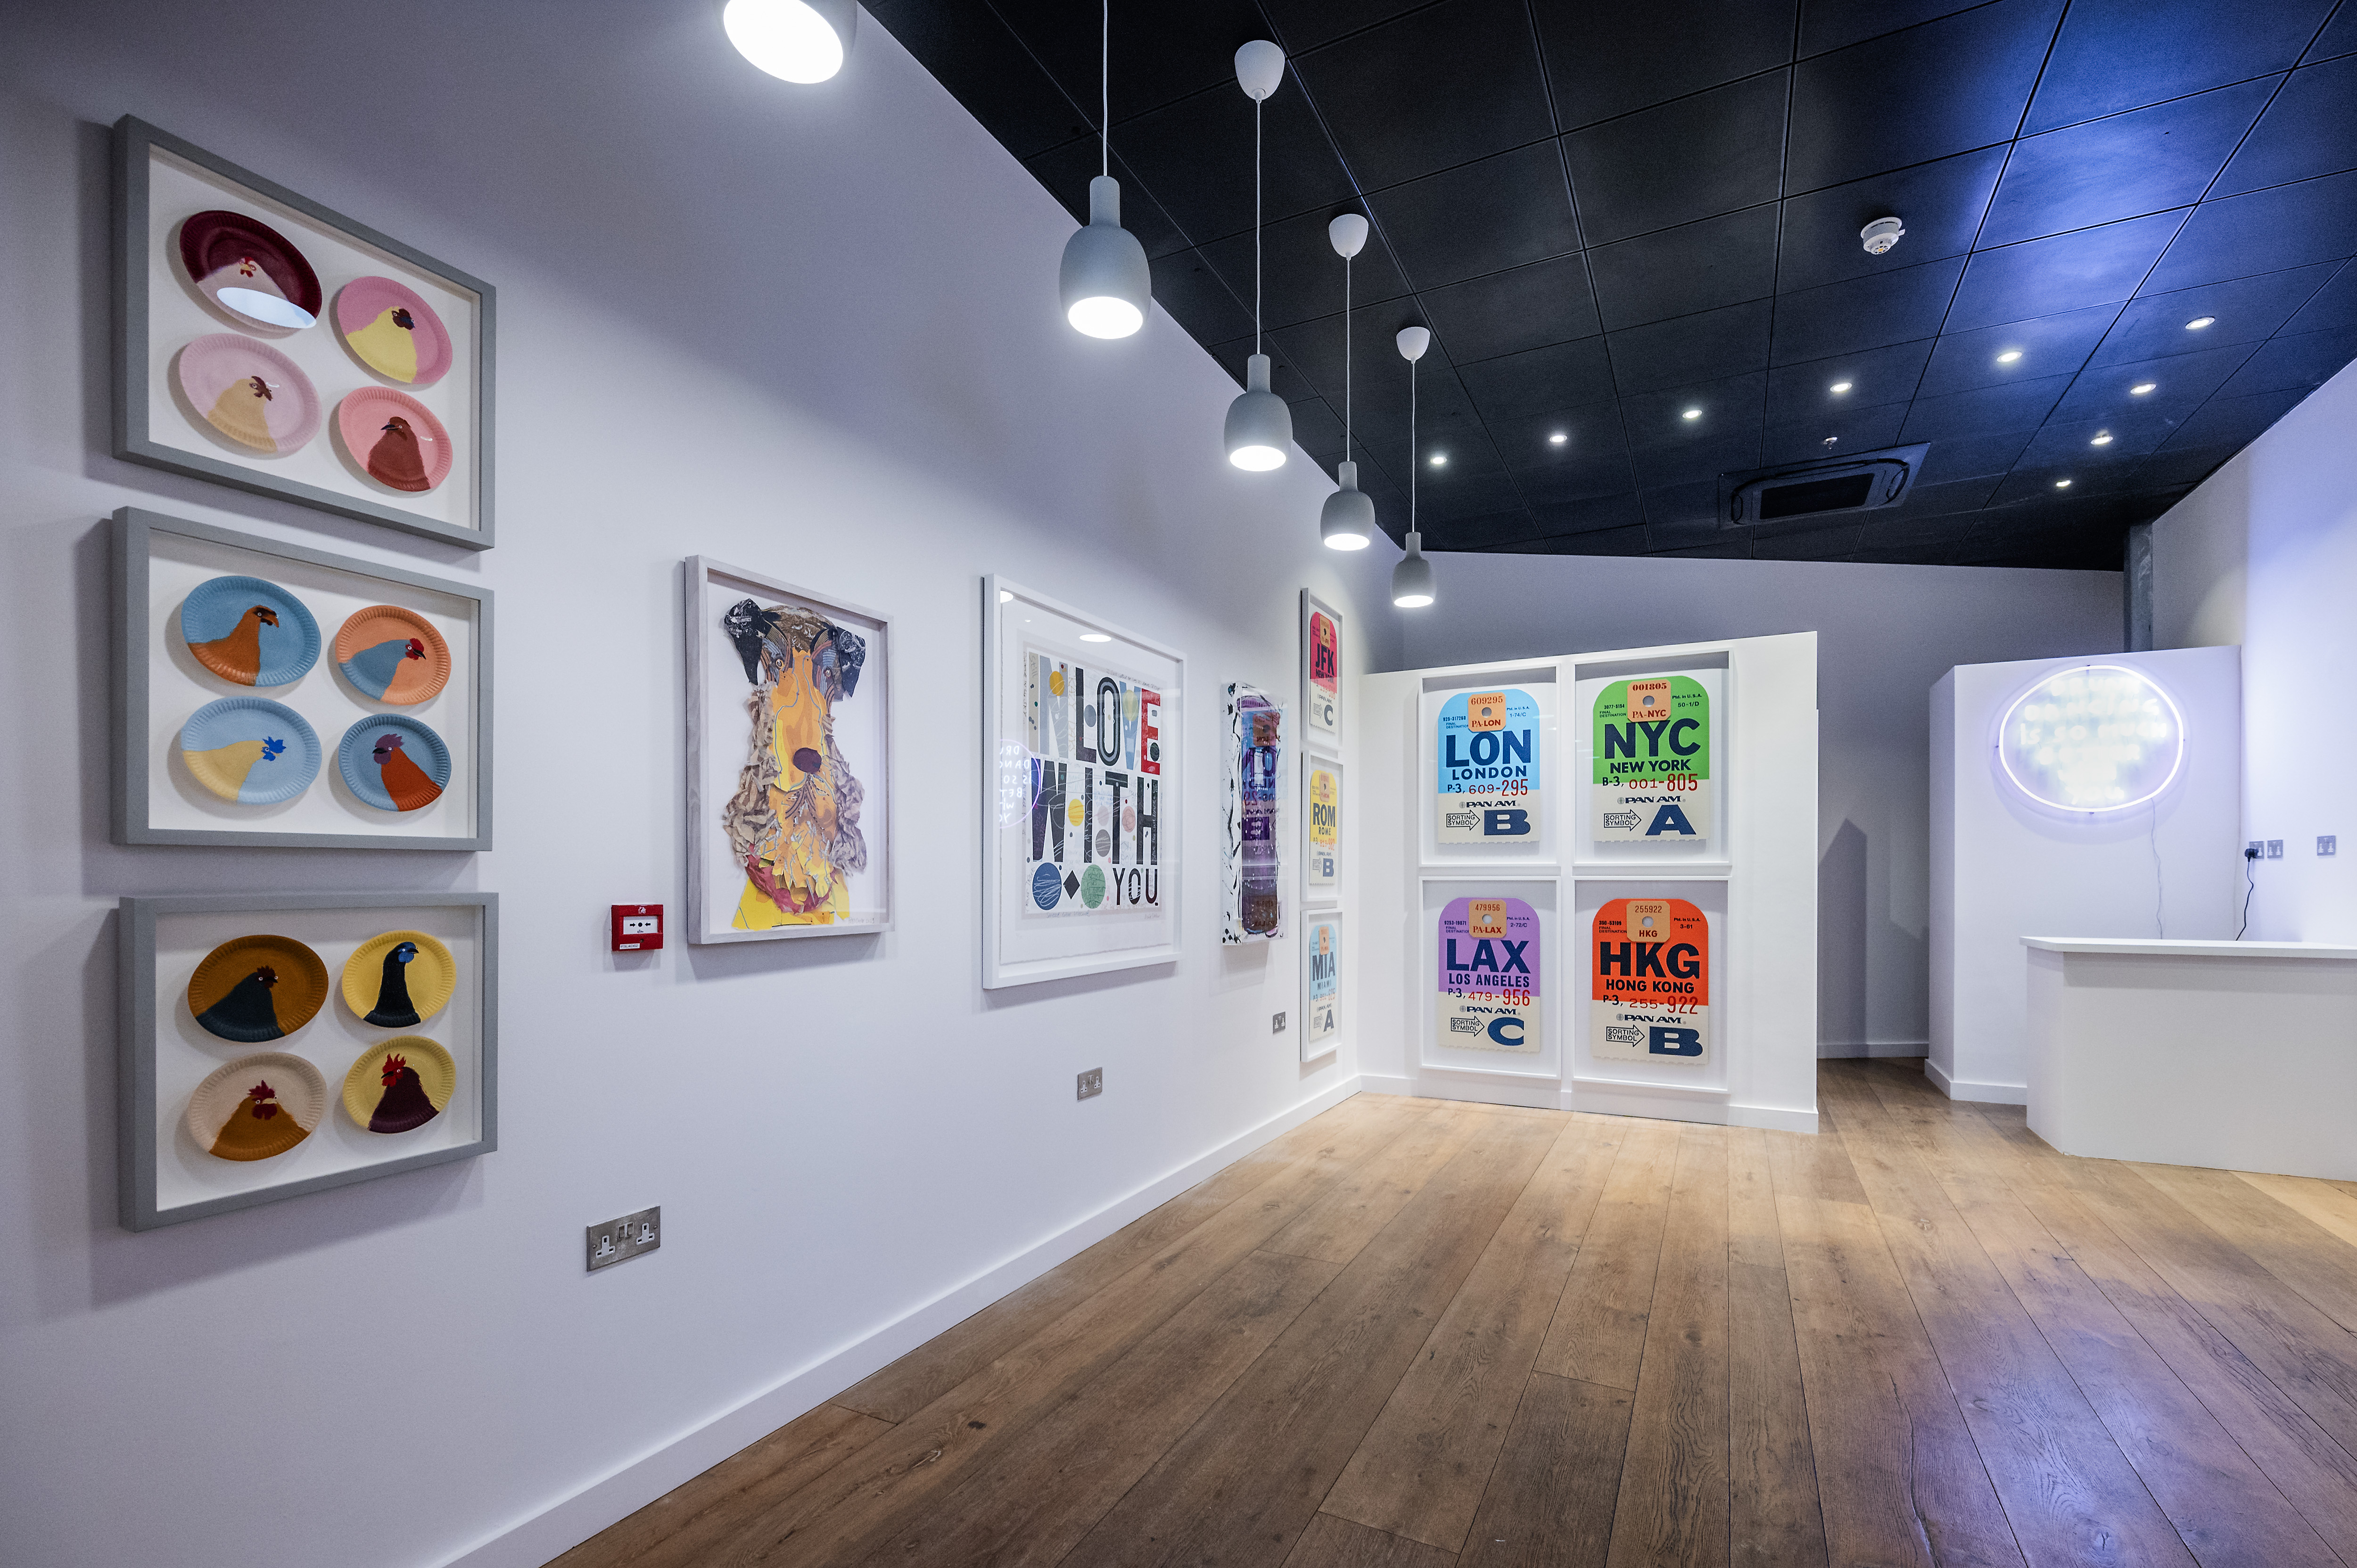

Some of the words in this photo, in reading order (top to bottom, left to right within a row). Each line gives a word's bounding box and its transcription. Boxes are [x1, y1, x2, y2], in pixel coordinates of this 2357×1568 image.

[1315, 643, 1335, 676] JFK
[1632, 682, 1667, 691] 001805
[1471, 696, 1503, 705] 609295
[1075, 666, 1161, 775] LOVE
[1324, 705, 1333, 726] C
[1632, 709, 1666, 718] PA-NYC
[1471, 719, 1501, 728] PA-LON
[2053, 725, 2087, 743] SO
[2098, 722, 2167, 738] MUCH
[1605, 718, 1701, 759] NYC
[1446, 729, 1531, 768] LON
[1452, 765, 1527, 781] LONDON
[1610, 761, 1645, 774] NEW
[1648, 758, 1692, 772] YORK
[1468, 779, 1528, 796] 609-295
[1629, 773, 1698, 792] 001-805
[1624, 796, 1656, 804] PAN
[1031, 757, 1158, 865] WITH
[1313, 803, 1335, 827] ROM
[1645, 804, 1697, 836] A
[1319, 827, 1331, 836] ROME
[1484, 809, 1531, 836] B
[1323, 858, 1334, 877] B
[1473, 926, 1502, 934] PA-LAX
[1446, 938, 1531, 974] LAX
[1600, 942, 1700, 979] HKG
[1312, 952, 1335, 981] MIA
[1317, 979, 1332, 990] MIAMI
[1449, 973, 1471, 985] LOS
[1475, 974, 1530, 987] ANGELES
[1606, 978, 1647, 992] HONG
[1653, 981, 1695, 994] KONG
[1466, 1006, 1493, 1014] PAN
[1629, 995, 1698, 1015] 255-922
[1323, 1009, 1334, 1032] A
[1624, 1014, 1655, 1023] PAN
[1656, 1016, 1681, 1024] AM
[1487, 1017, 1525, 1046] C
[1608, 1028, 1640, 1036] SORTING
[1608, 1034, 1638, 1042] SYMBOL
[1649, 1026, 1703, 1057] B
